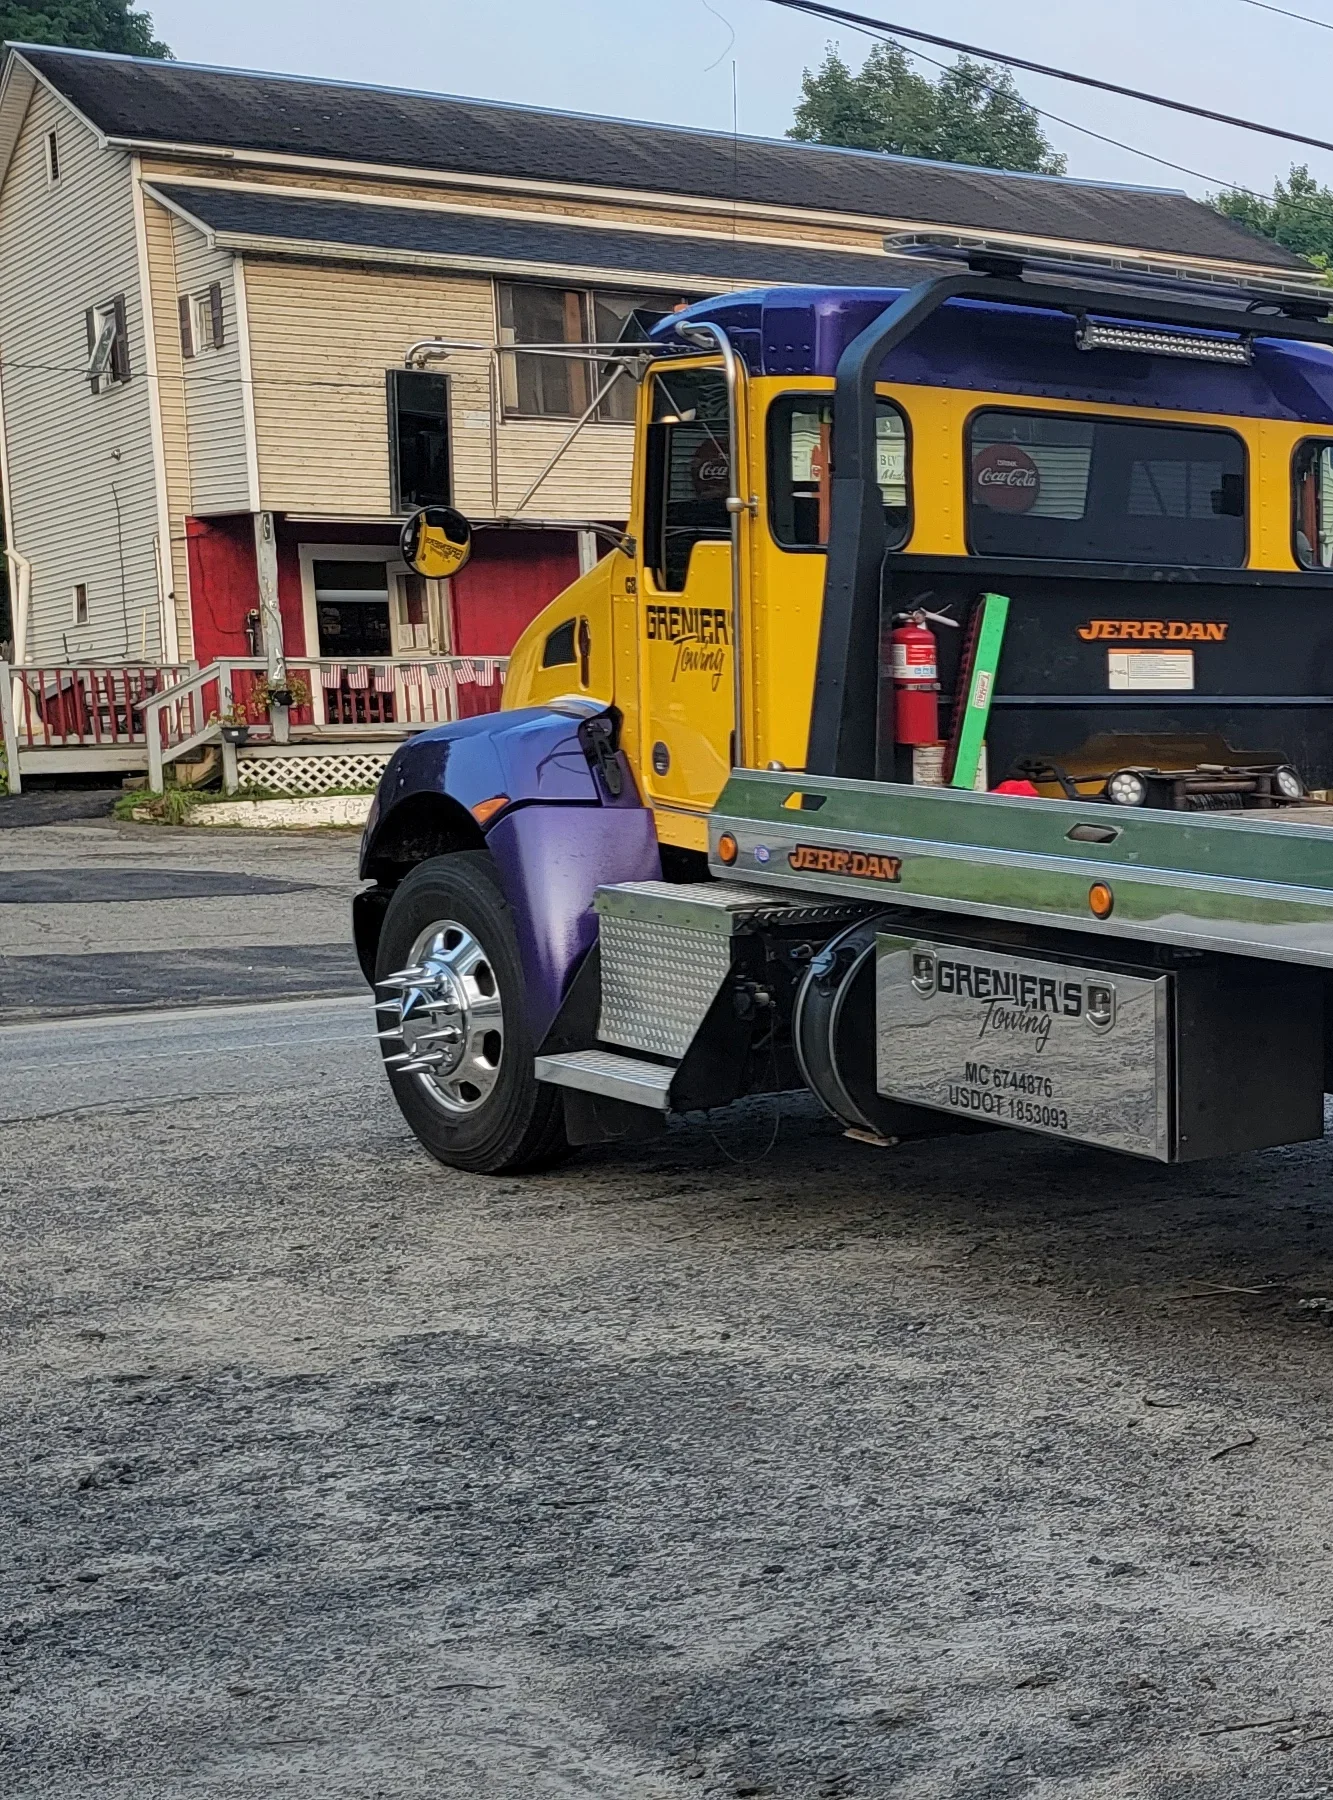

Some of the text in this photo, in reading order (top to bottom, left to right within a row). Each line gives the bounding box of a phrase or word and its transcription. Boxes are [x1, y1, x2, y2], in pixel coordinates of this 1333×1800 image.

[978, 467, 1036, 487] Coca-Cola
[646, 605, 732, 645] GRENIER'
[1078, 620, 1228, 641] JERR-DAN
[671, 634, 725, 692] Towing
[789, 846, 899, 880] JERR-DAN
[937, 960, 1082, 1017] GRENIER'S
[978, 996, 1053, 1053] Towing
[965, 1062, 1053, 1097] MC 6744876
[949, 1085, 1068, 1129] USDOT 1853093
